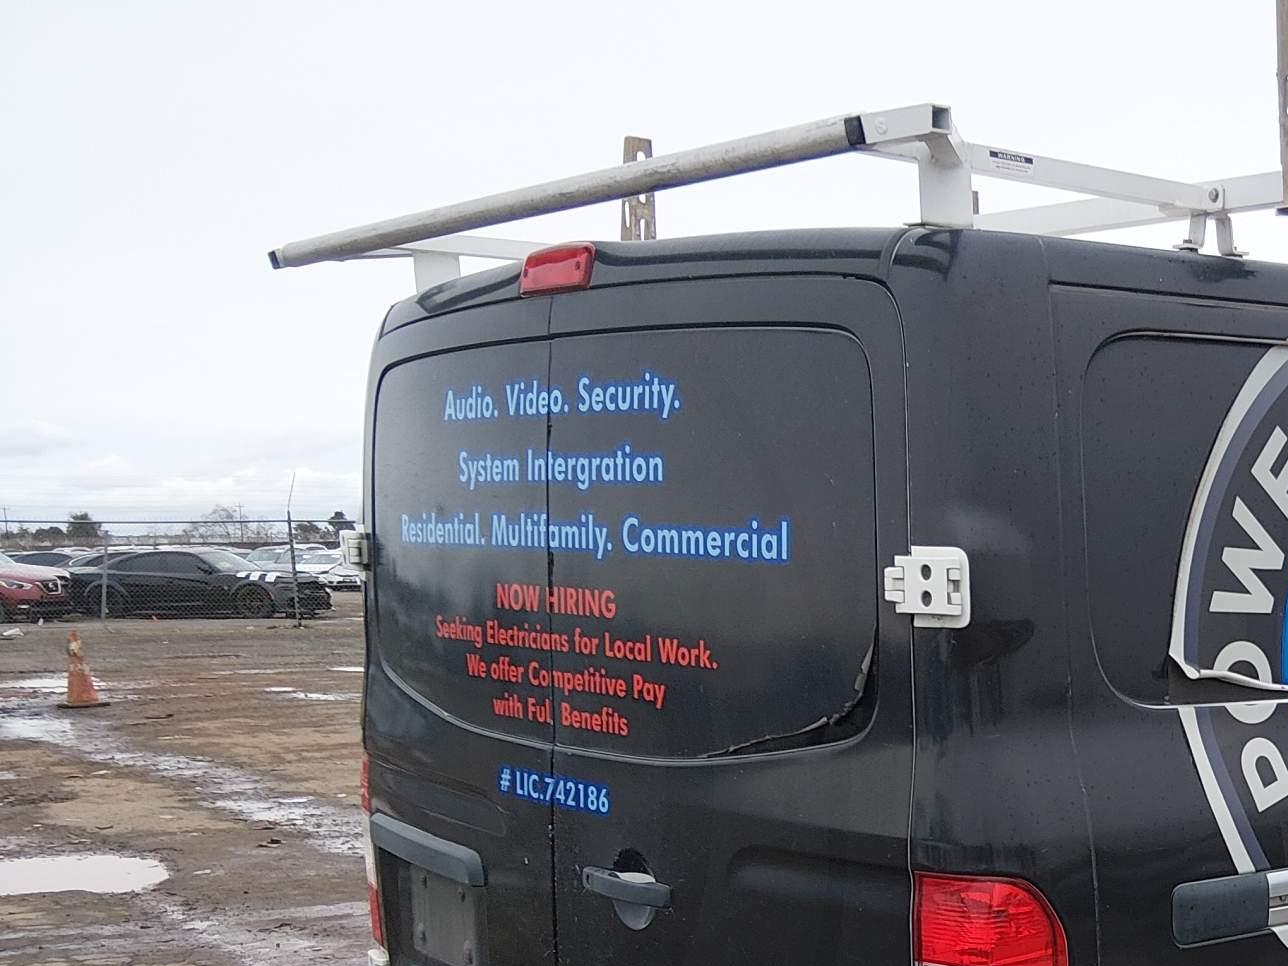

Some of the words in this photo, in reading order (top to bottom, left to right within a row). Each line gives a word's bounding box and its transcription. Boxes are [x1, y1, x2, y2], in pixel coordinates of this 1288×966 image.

[444, 385, 499, 421] Audio.
[506, 380, 569, 416] Video.
[578, 372, 680, 419] Security.
[458, 450, 520, 490] System
[527, 445, 664, 490] Intergration
[401, 513, 485, 546] Residential.
[491, 513, 613, 559] Multifamily.
[623, 516, 789, 560] Commercial
[496, 583, 540, 612] NOW
[545, 586, 617, 619] HIRING
[435, 615, 483, 647] Seeking
[486, 620, 569, 653] Electricians
[574, 628, 599, 655] for
[604, 632, 651, 662] Local
[658, 637, 719, 670] Work.
[466, 653, 487, 678] We
[491, 656, 524, 683] offer
[528, 661, 626, 698] Competitive
[632, 674, 666, 709] Pay
[493, 692, 523, 720] with
[528, 697, 553, 725] Ful
[561, 702, 629, 736] Benefits
[500, 768, 512, 792] #
[516, 770, 609, 814] LIC.742186
